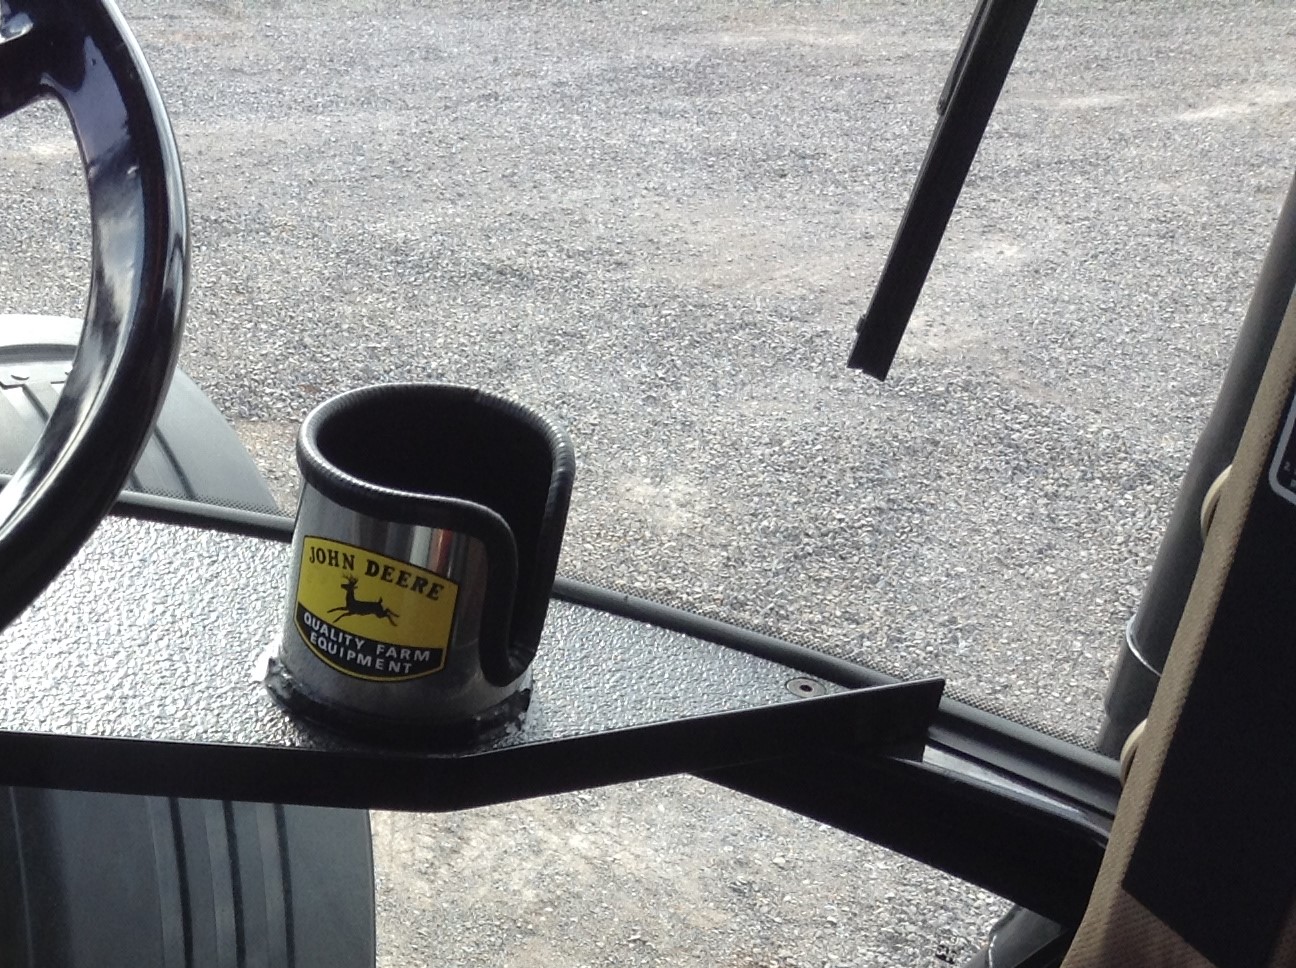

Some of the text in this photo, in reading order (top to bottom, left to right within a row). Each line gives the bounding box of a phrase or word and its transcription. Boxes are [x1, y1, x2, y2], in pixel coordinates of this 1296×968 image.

[309, 546, 445, 601] JOHN DEERE
[303, 611, 431, 662] QUALITY FARM
[310, 632, 413, 674] EQUIPMENT
